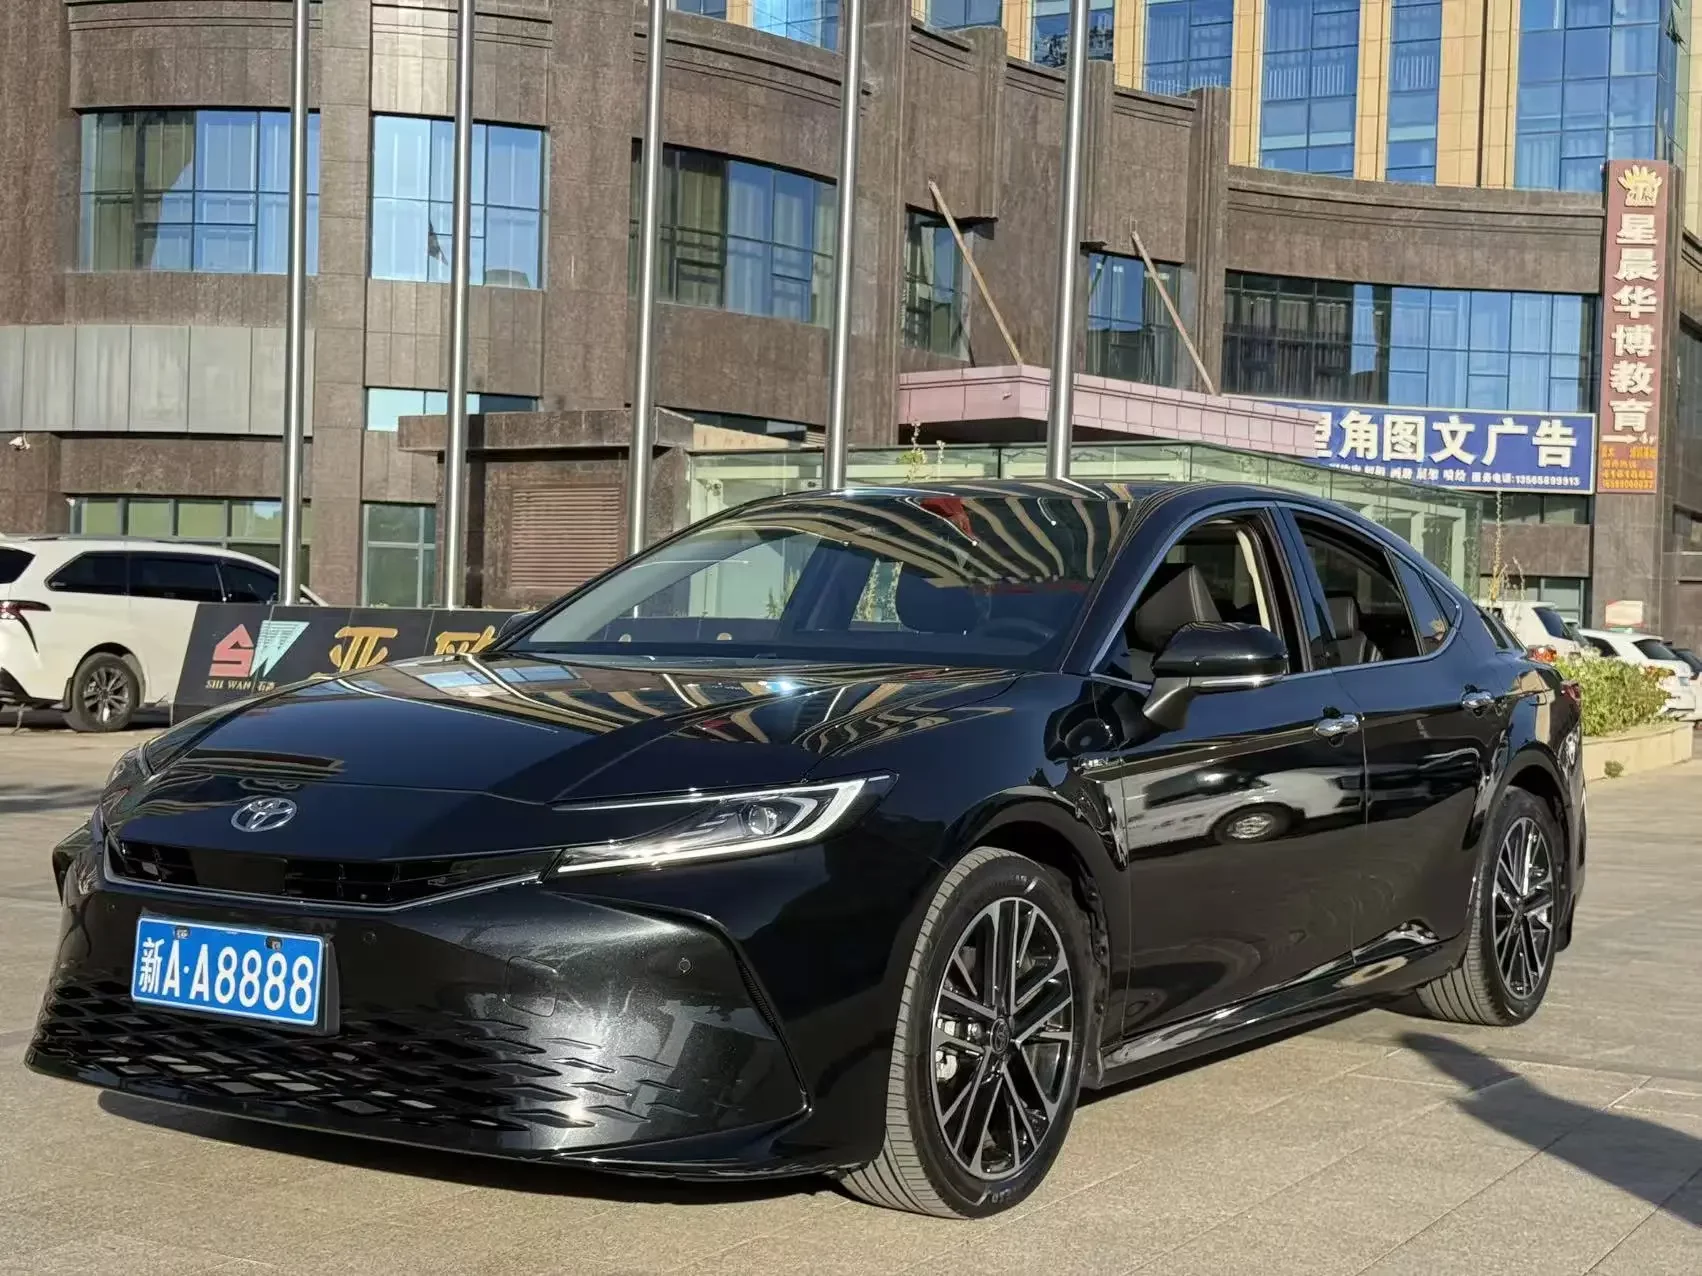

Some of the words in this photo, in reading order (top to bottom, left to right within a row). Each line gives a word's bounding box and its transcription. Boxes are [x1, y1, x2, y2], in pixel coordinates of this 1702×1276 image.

[1609, 213, 1660, 432] 星晨华博教育
[138, 936, 314, 1015] 新A·A8888
